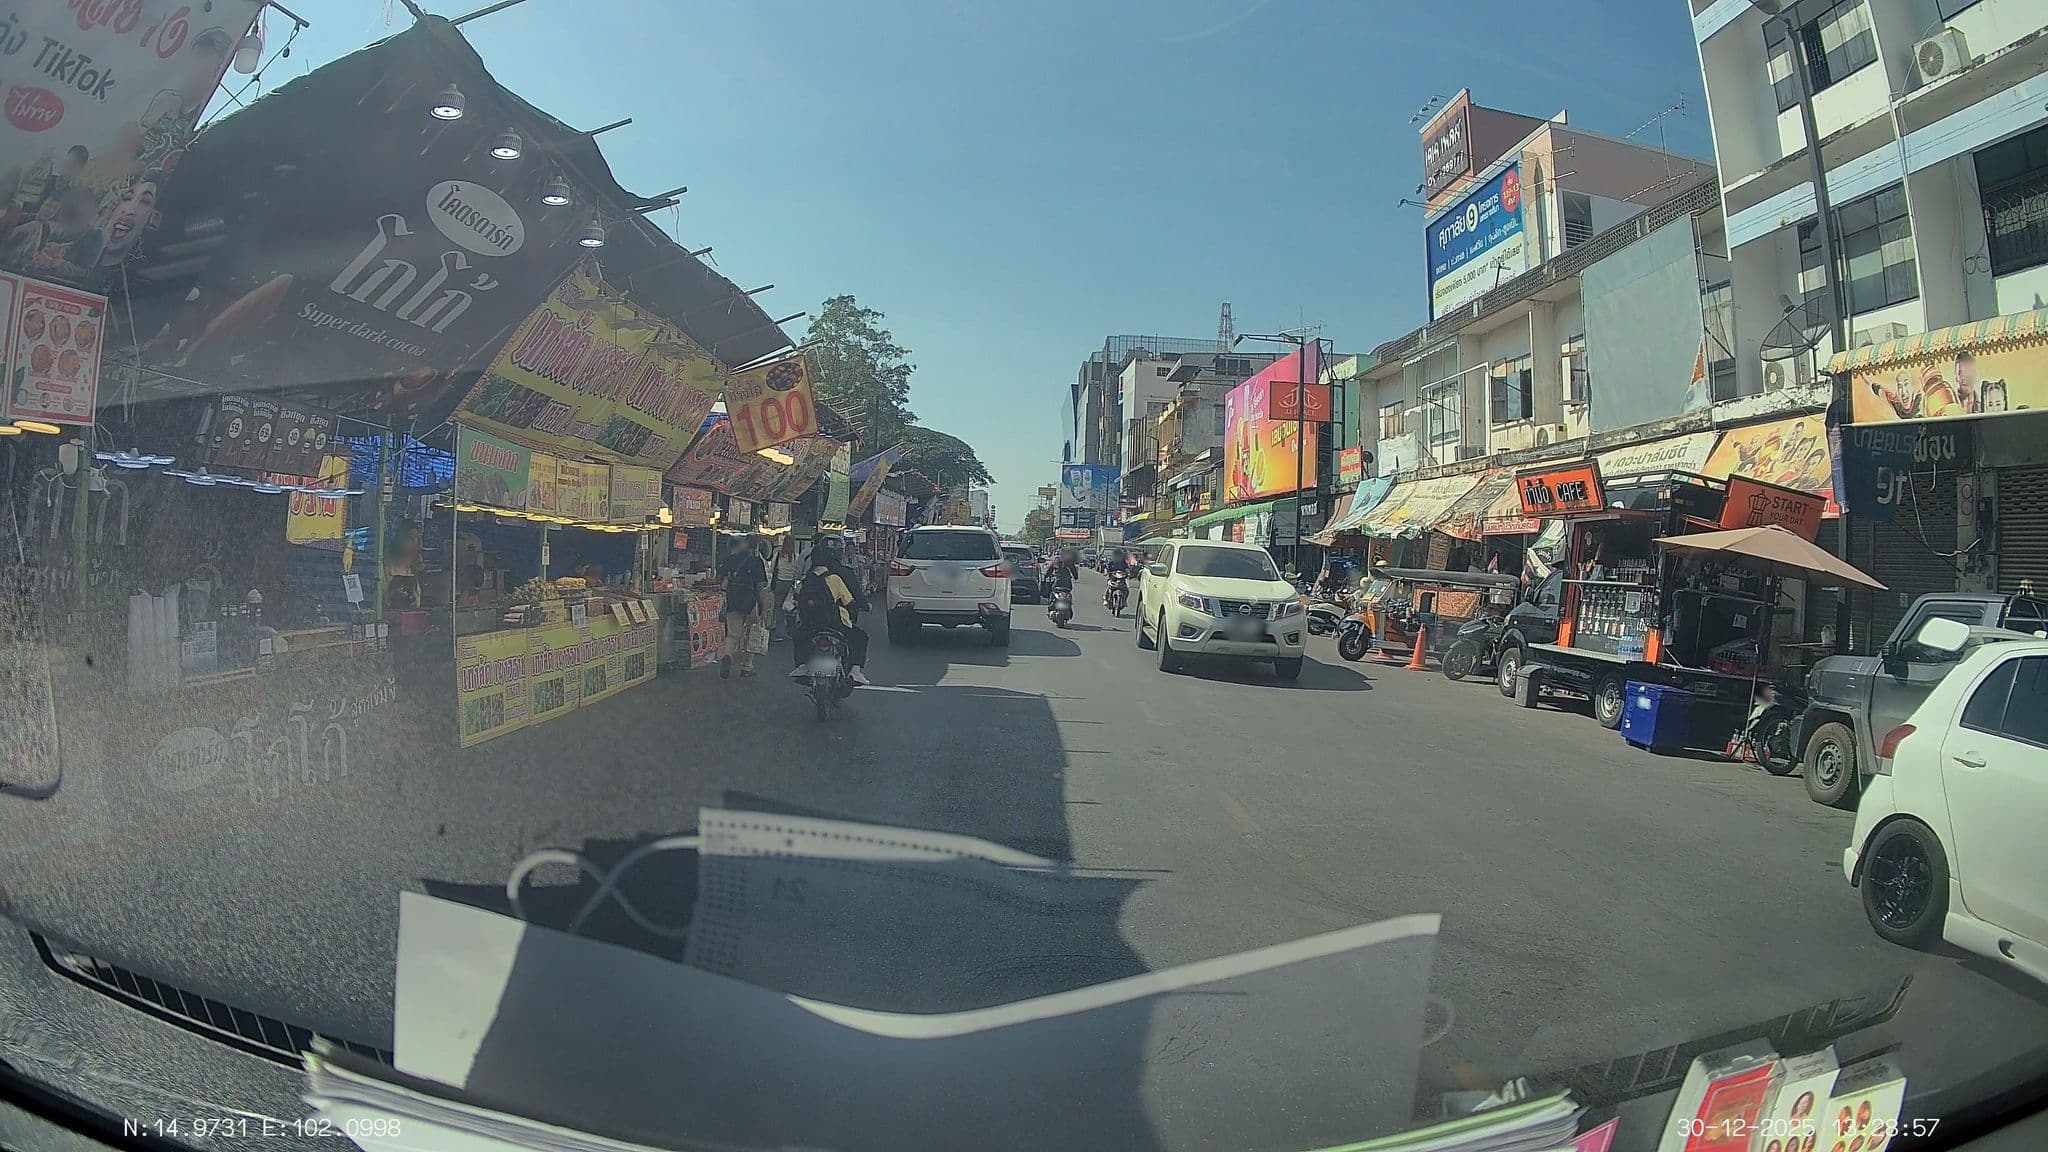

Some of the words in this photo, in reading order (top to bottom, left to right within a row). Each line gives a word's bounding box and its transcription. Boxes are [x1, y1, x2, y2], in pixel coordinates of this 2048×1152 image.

[33, 36, 116, 101] TikTok
[1439, 215, 1466, 251] ศุภาลัย
[1469, 209, 1475, 227] 9
[329, 213, 500, 334] โกโก้
[297, 302, 351, 330] Super
[349, 322, 387, 344] dark
[385, 336, 426, 358] cocoa
[229, 422, 240, 434] 59
[736, 391, 808, 446] 100
[1556, 481, 1584, 502] CAFE
[1772, 496, 1809, 515] START
[1770, 512, 1789, 523] YOUR
[1789, 516, 1804, 525] DAY
